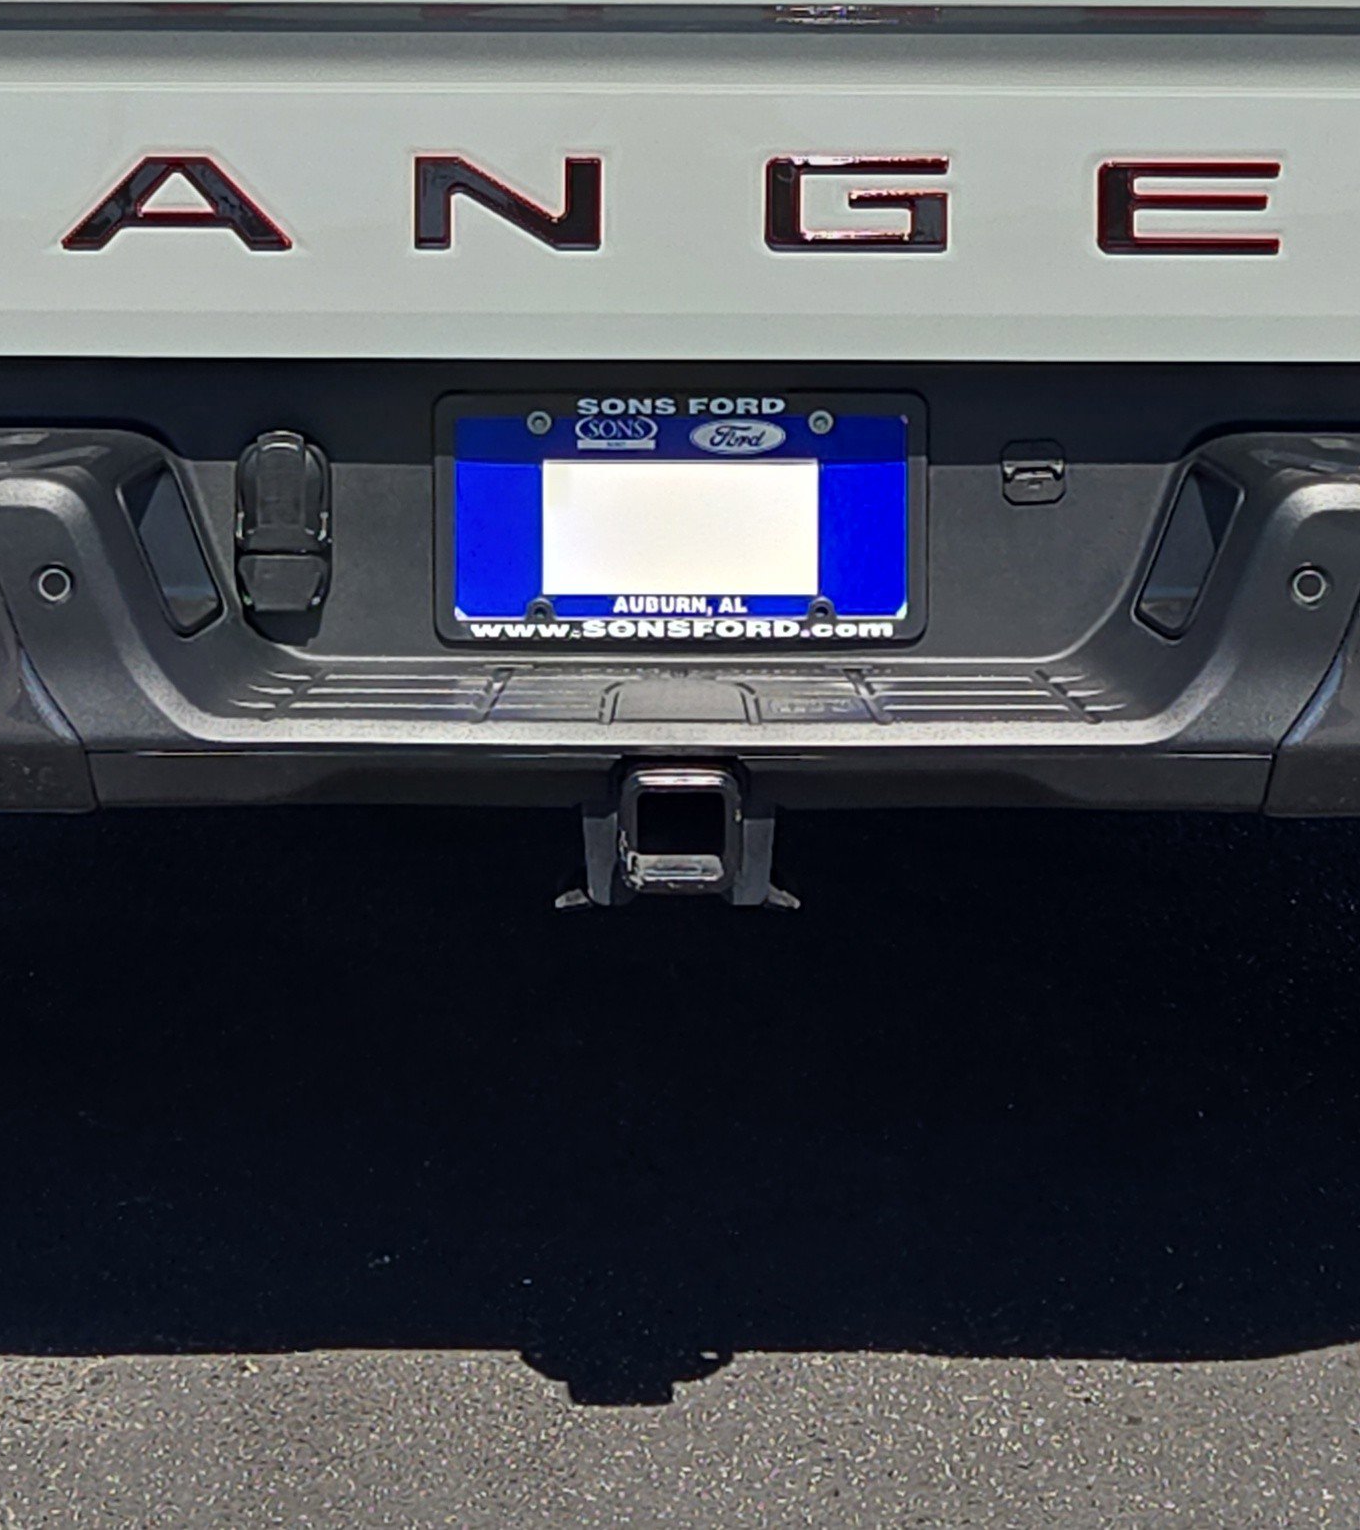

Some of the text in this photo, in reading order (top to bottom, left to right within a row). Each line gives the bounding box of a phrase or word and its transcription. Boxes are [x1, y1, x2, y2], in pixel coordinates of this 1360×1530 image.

[576, 397, 787, 416] SONS FORD
[587, 418, 646, 439] SONS
[708, 424, 767, 449] Ford
[612, 596, 749, 617] AUBURN, AL
[470, 619, 895, 639] www.SONSFORD.com
